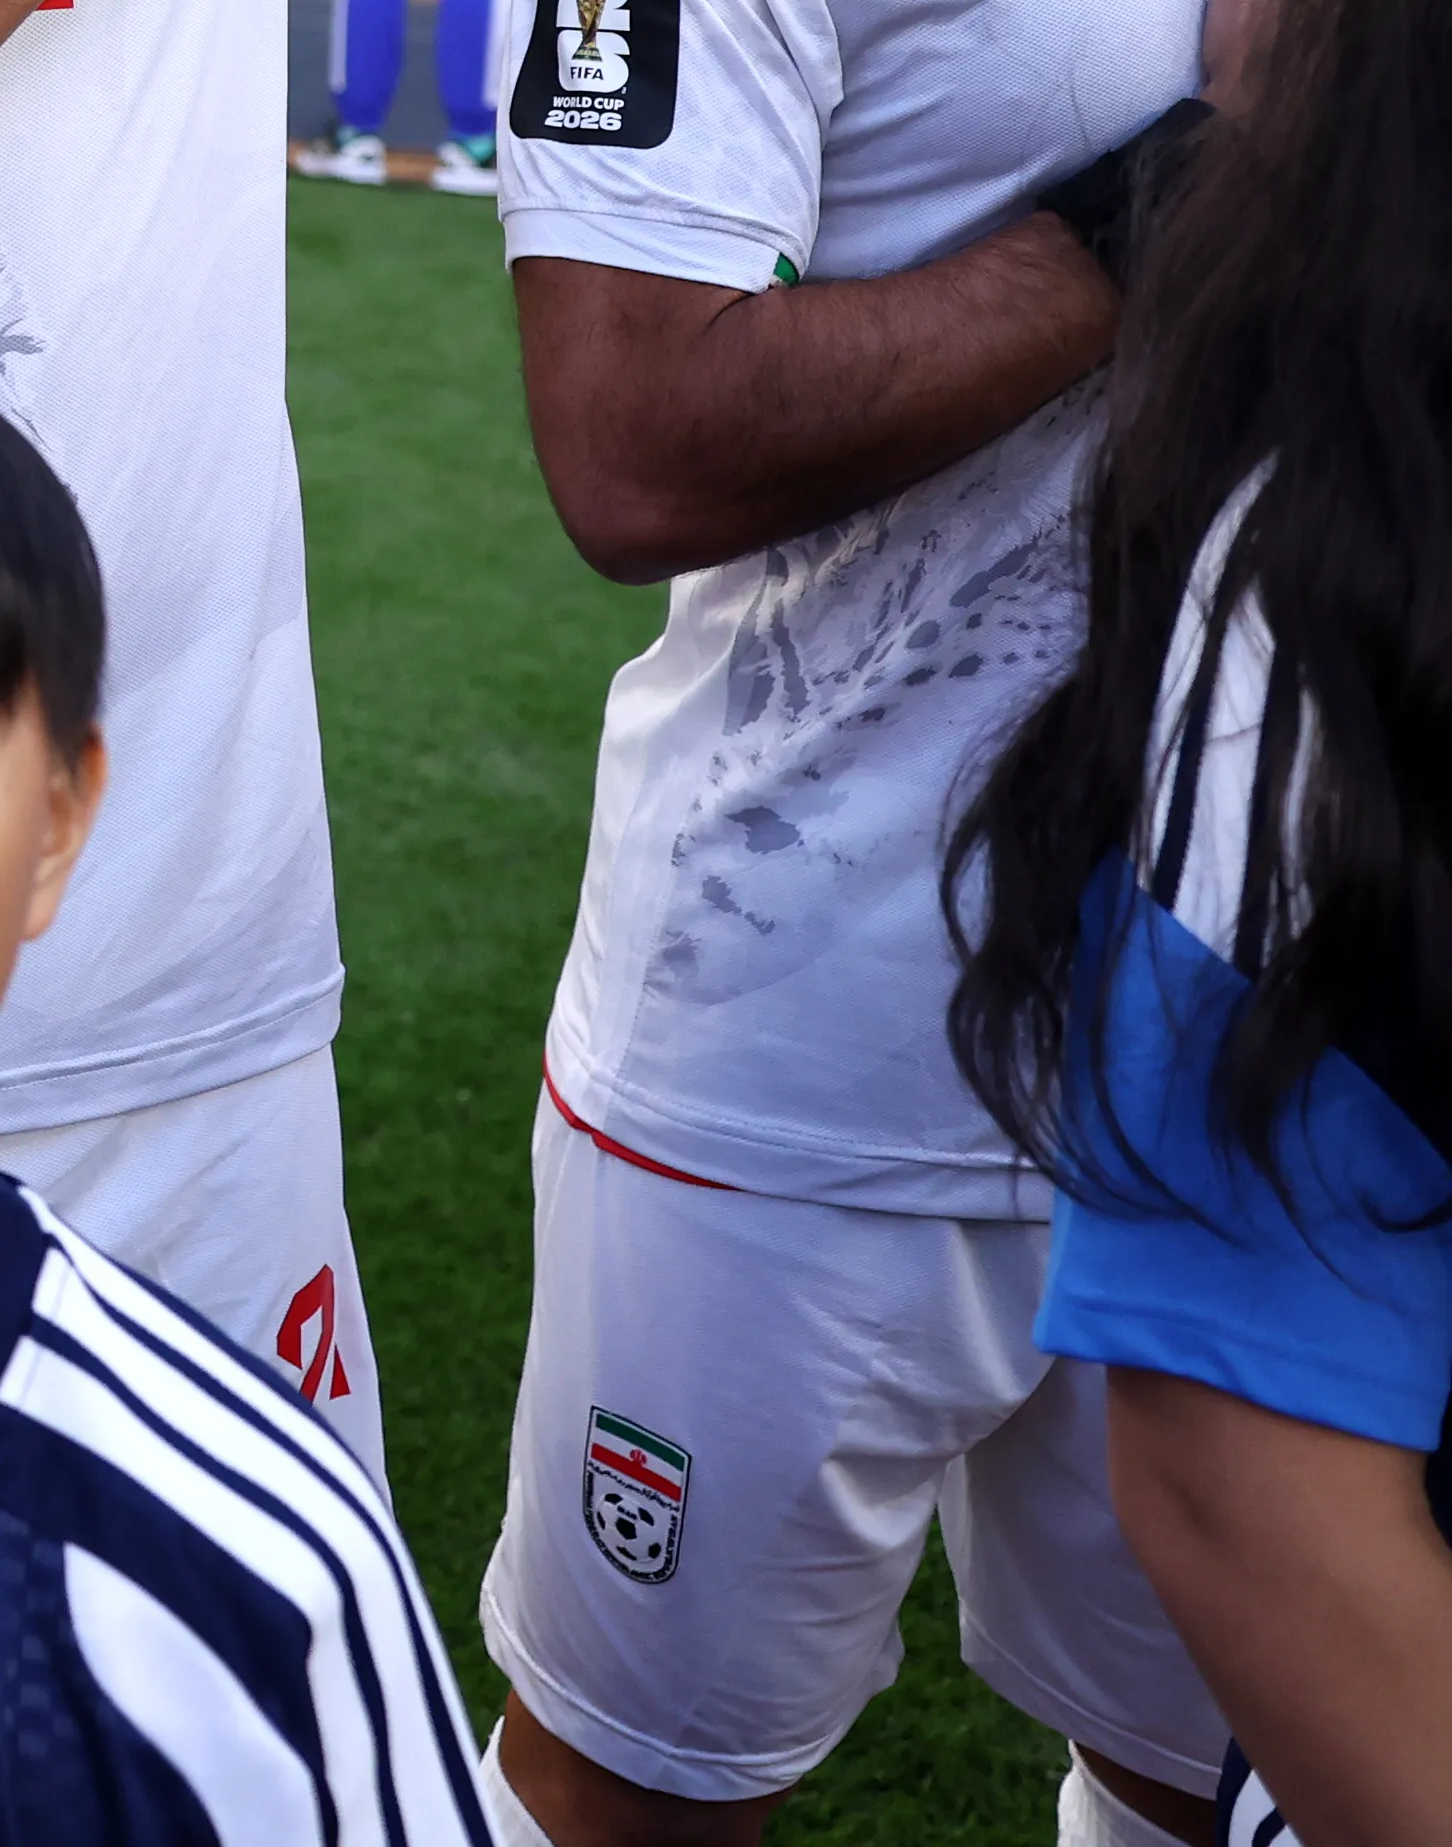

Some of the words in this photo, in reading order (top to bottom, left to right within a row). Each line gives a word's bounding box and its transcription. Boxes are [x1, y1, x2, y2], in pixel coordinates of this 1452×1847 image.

[570, 66, 604, 80] FIFA
[553, 96, 592, 108] WORLD
[594, 97, 625, 111] CUP
[544, 110, 622, 132] 2026
